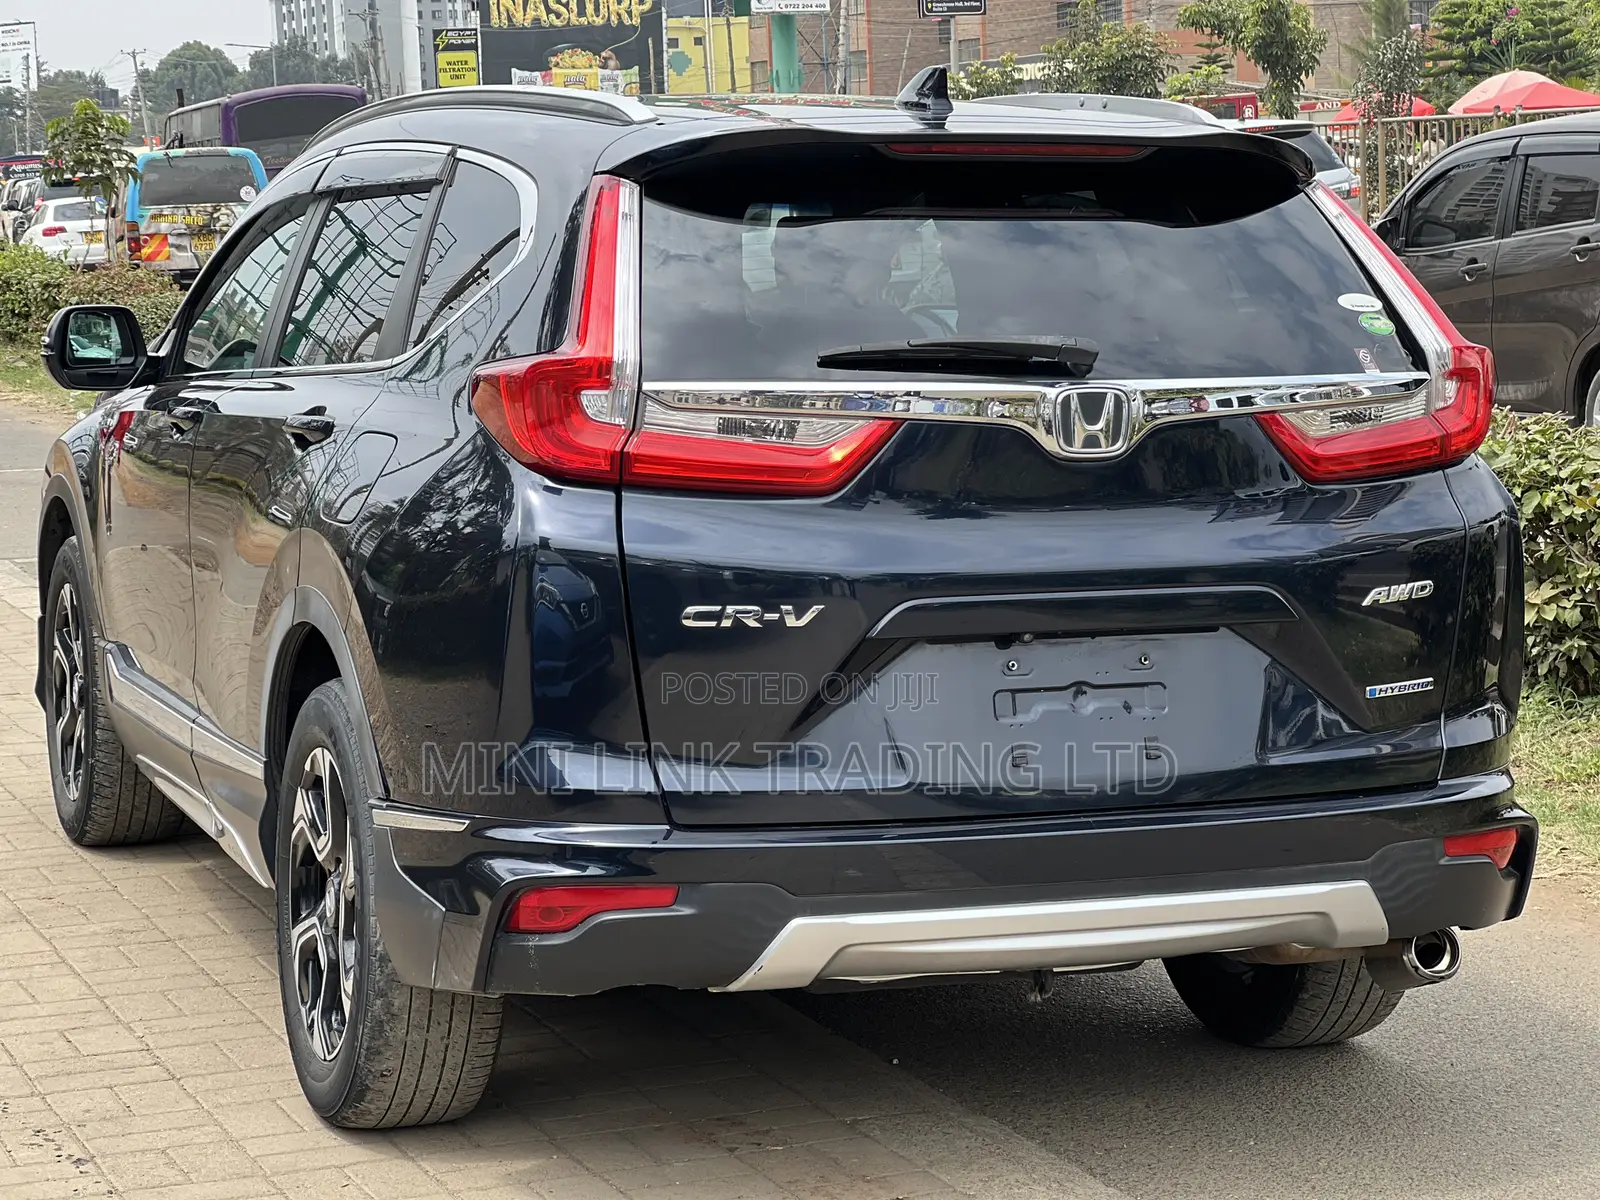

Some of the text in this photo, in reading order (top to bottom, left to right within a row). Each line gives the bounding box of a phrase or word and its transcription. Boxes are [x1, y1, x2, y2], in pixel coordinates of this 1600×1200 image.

[438, 66, 476, 74] FILTRATION
[564, 72, 586, 82] nala
[1315, 101, 1341, 110] AND
[181, 215, 204, 225] SACCO
[1361, 580, 1434, 607] AWD
[681, 604, 826, 628] CR-V
[1378, 680, 1434, 696] HYBRID
